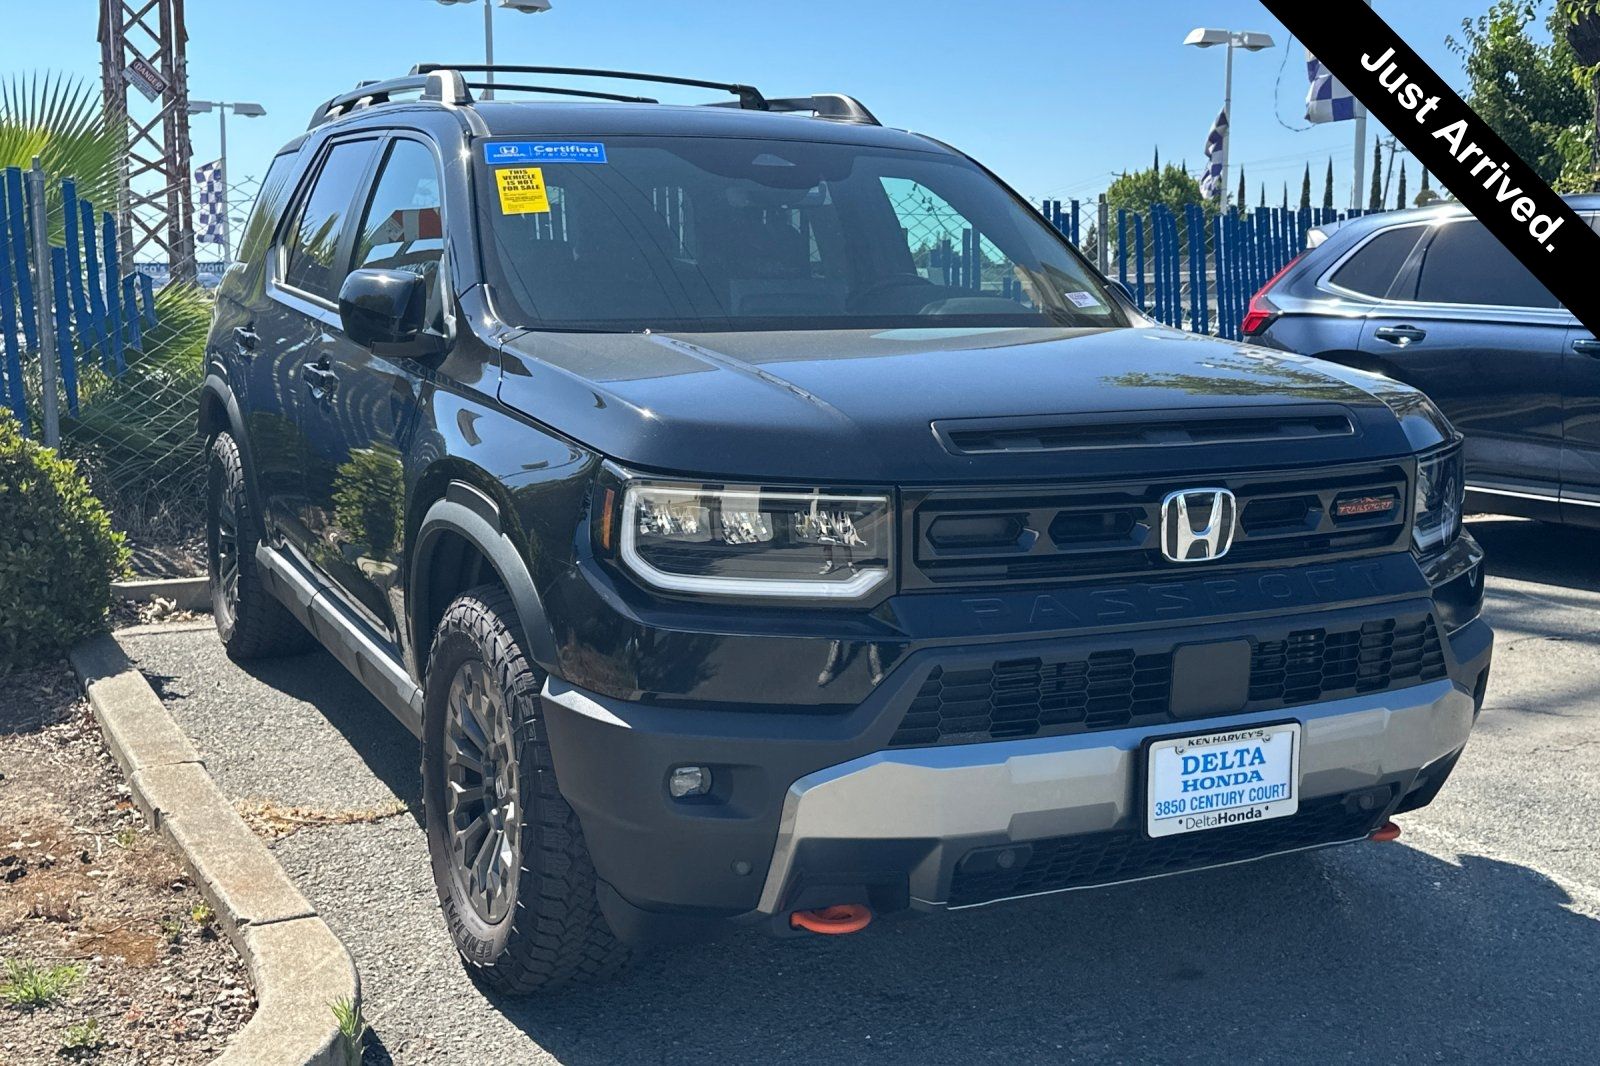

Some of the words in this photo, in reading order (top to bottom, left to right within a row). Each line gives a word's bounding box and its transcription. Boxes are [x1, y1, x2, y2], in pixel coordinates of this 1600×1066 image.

[134, 62, 163, 91] DANGER
[533, 145, 598, 153] Certified
[961, 561, 1384, 629] PASSPORT
[1187, 737, 1211, 747] KEN
[1212, 730, 1264, 743] HARVEY'S
[1181, 747, 1266, 775] DELTA
[1181, 770, 1264, 793] HONDA
[1155, 798, 1186, 817] 3850
[1190, 789, 1245, 811] CENTURY
[1249, 782, 1287, 802] COURT
